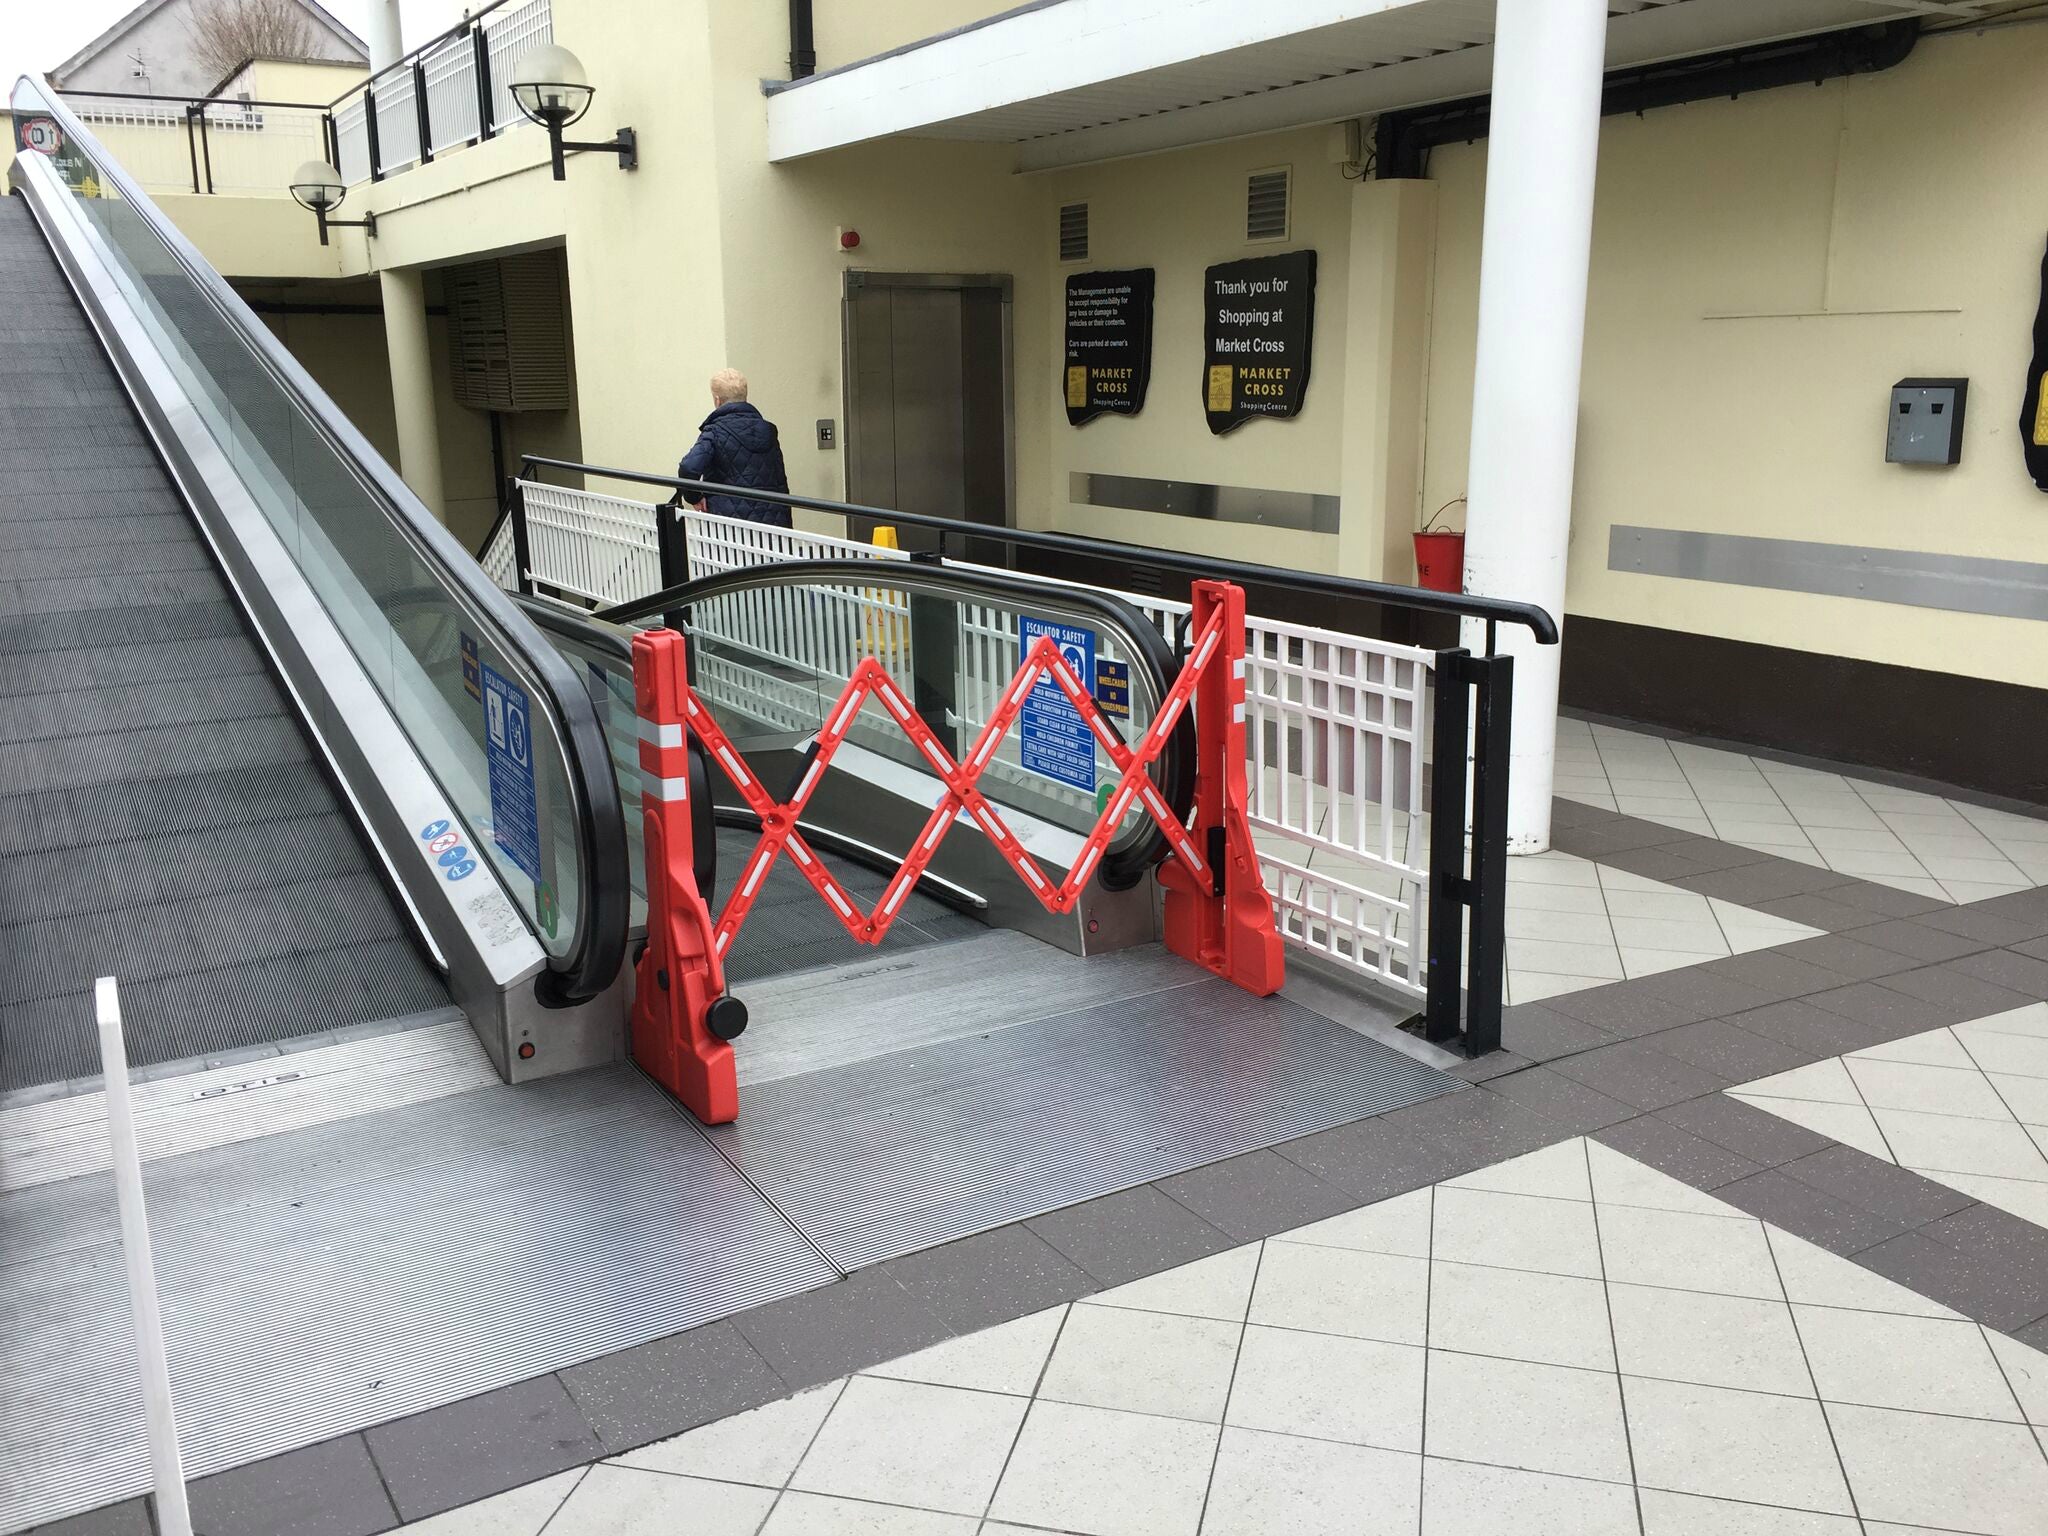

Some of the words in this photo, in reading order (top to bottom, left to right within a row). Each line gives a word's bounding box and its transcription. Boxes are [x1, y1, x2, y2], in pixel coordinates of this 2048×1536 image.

[1078, 288, 1107, 297] Management
[1115, 286, 1131, 294] unable
[1215, 280, 1247, 294] Thank
[1250, 282, 1269, 297] you
[1272, 278, 1288, 292] for
[1074, 299, 1089, 307] accept
[1090, 298, 1120, 306] responsibility
[1069, 310, 1077, 318] any
[1094, 309, 1112, 317] damage
[1219, 309, 1270, 326] Shopping
[1272, 309, 1283, 322] at
[1088, 339, 1104, 348] parked
[1110, 339, 1128, 347] owner's
[1215, 338, 1250, 352] Market
[1253, 338, 1285, 352] Cross
[1092, 368, 1133, 379] MARKET
[1240, 368, 1291, 379] MARKET
[1096, 383, 1128, 393] CROSS
[1245, 384, 1284, 396] CROSS
[1026, 622, 1060, 639] ESCALATOR
[1062, 630, 1086, 645] SAFETY
